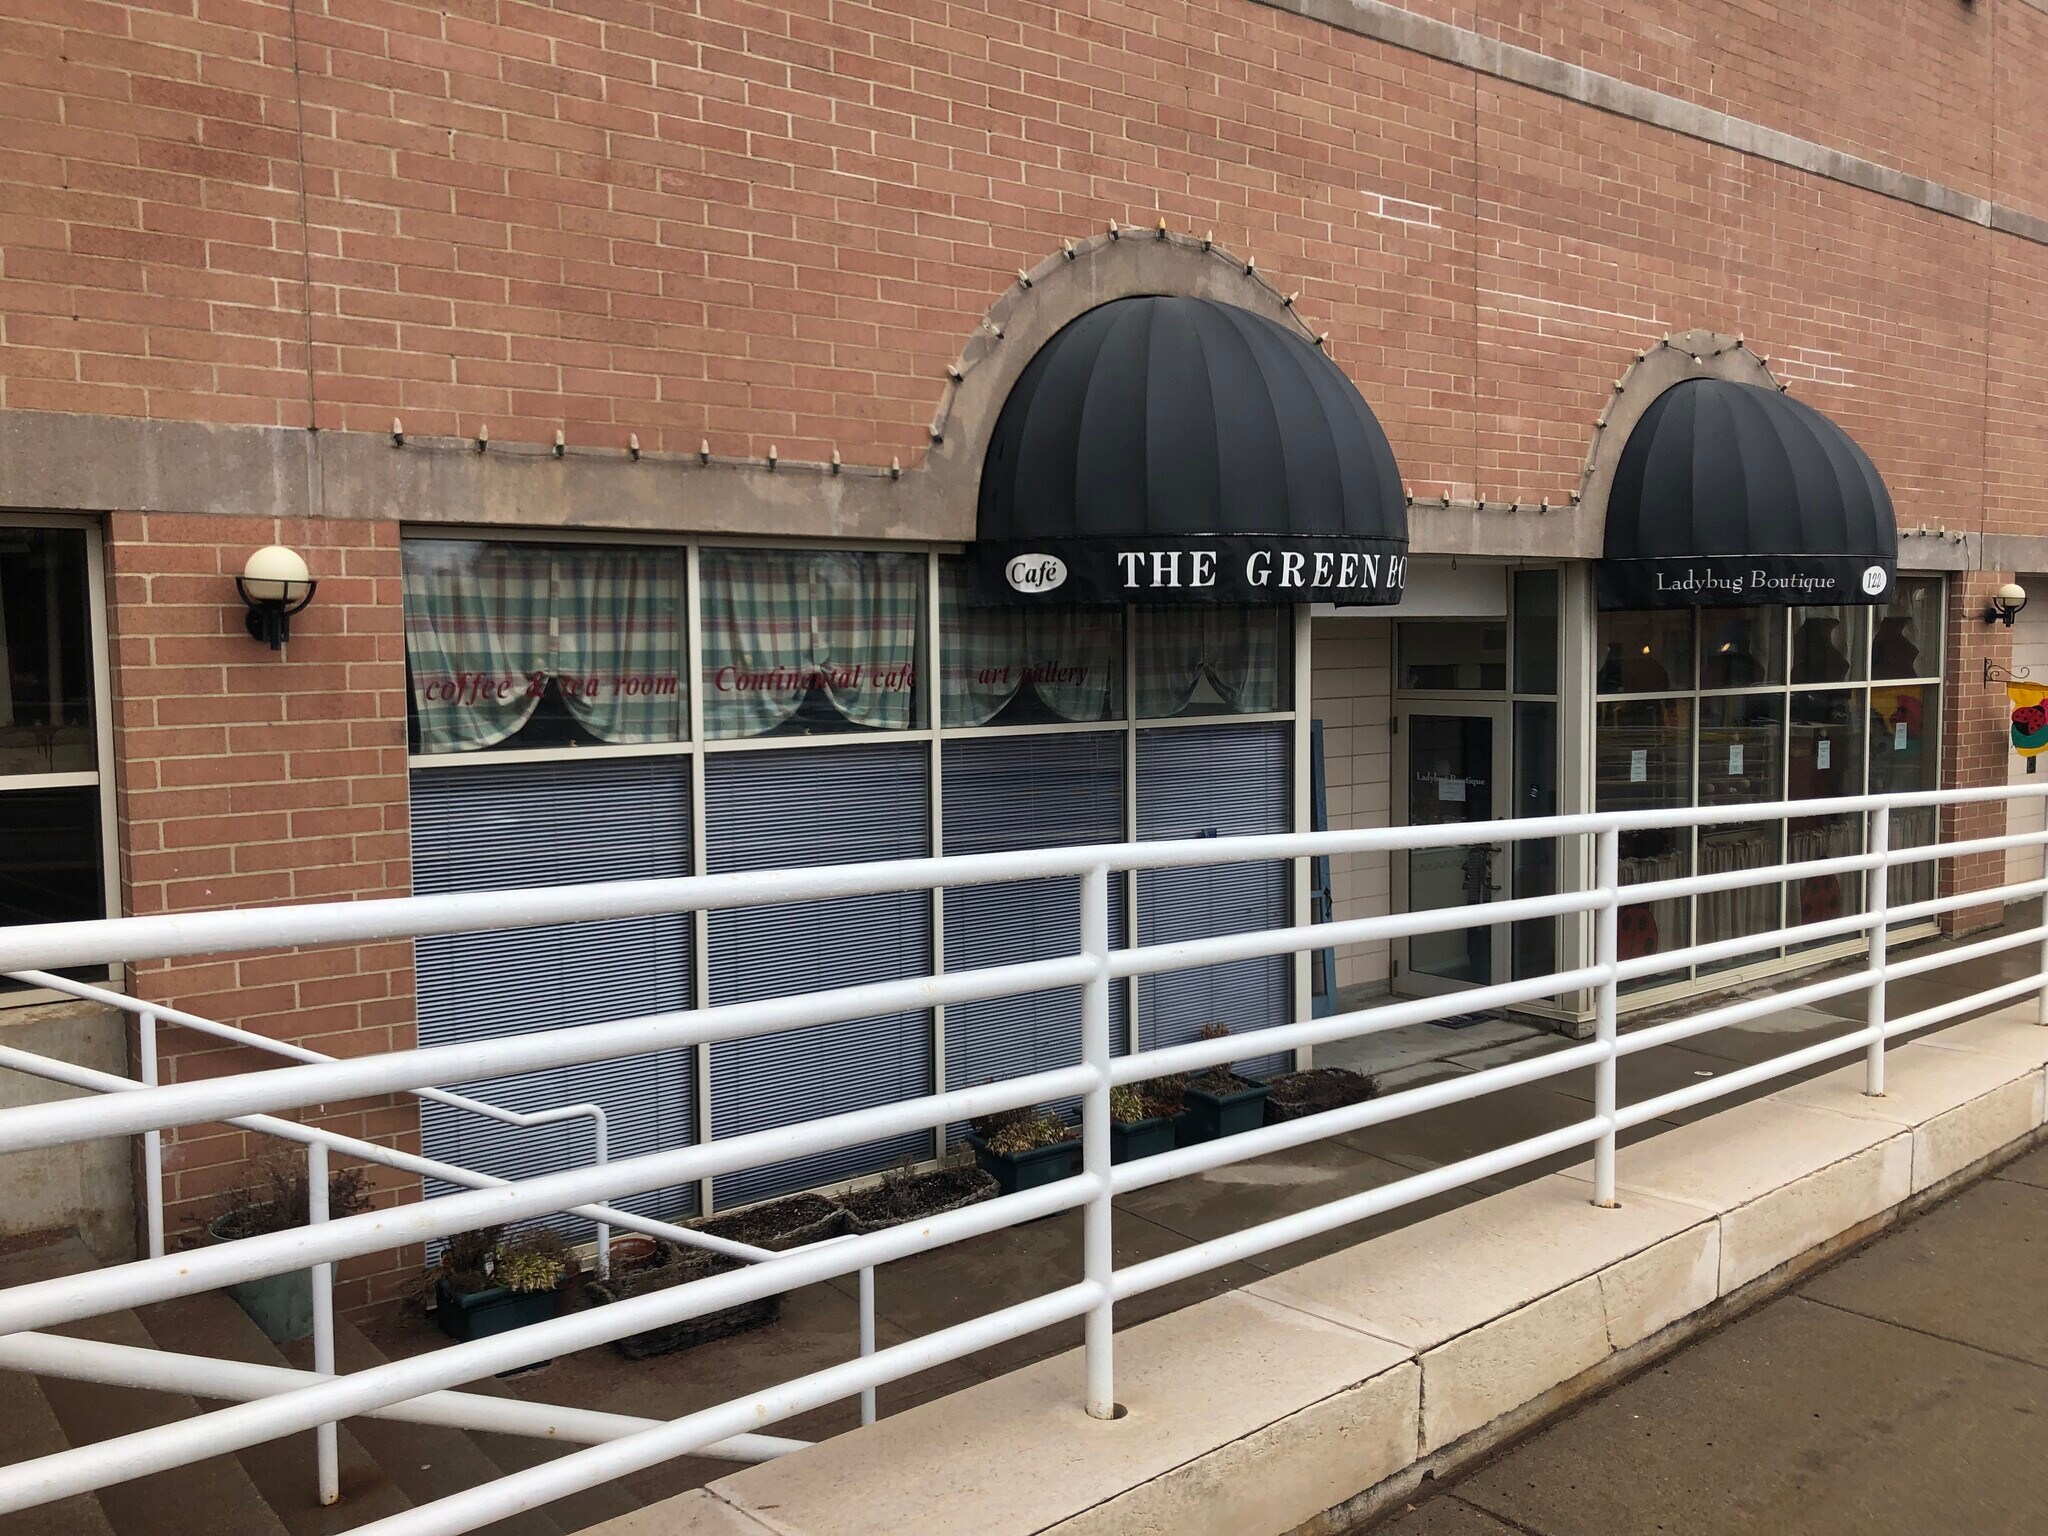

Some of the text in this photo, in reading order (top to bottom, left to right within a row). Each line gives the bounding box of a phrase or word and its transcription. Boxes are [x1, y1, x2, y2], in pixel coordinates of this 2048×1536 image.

[1011, 562, 1057, 587] Café
[1117, 551, 1218, 588] THE
[1246, 551, 1381, 589] GREEN
[1656, 568, 1836, 594] Ladybug Boutique
[1866, 572, 1882, 589] 122
[715, 664, 862, 691] Continental
[978, 660, 1089, 687] art gallery
[426, 671, 678, 706] coffee & tea room
